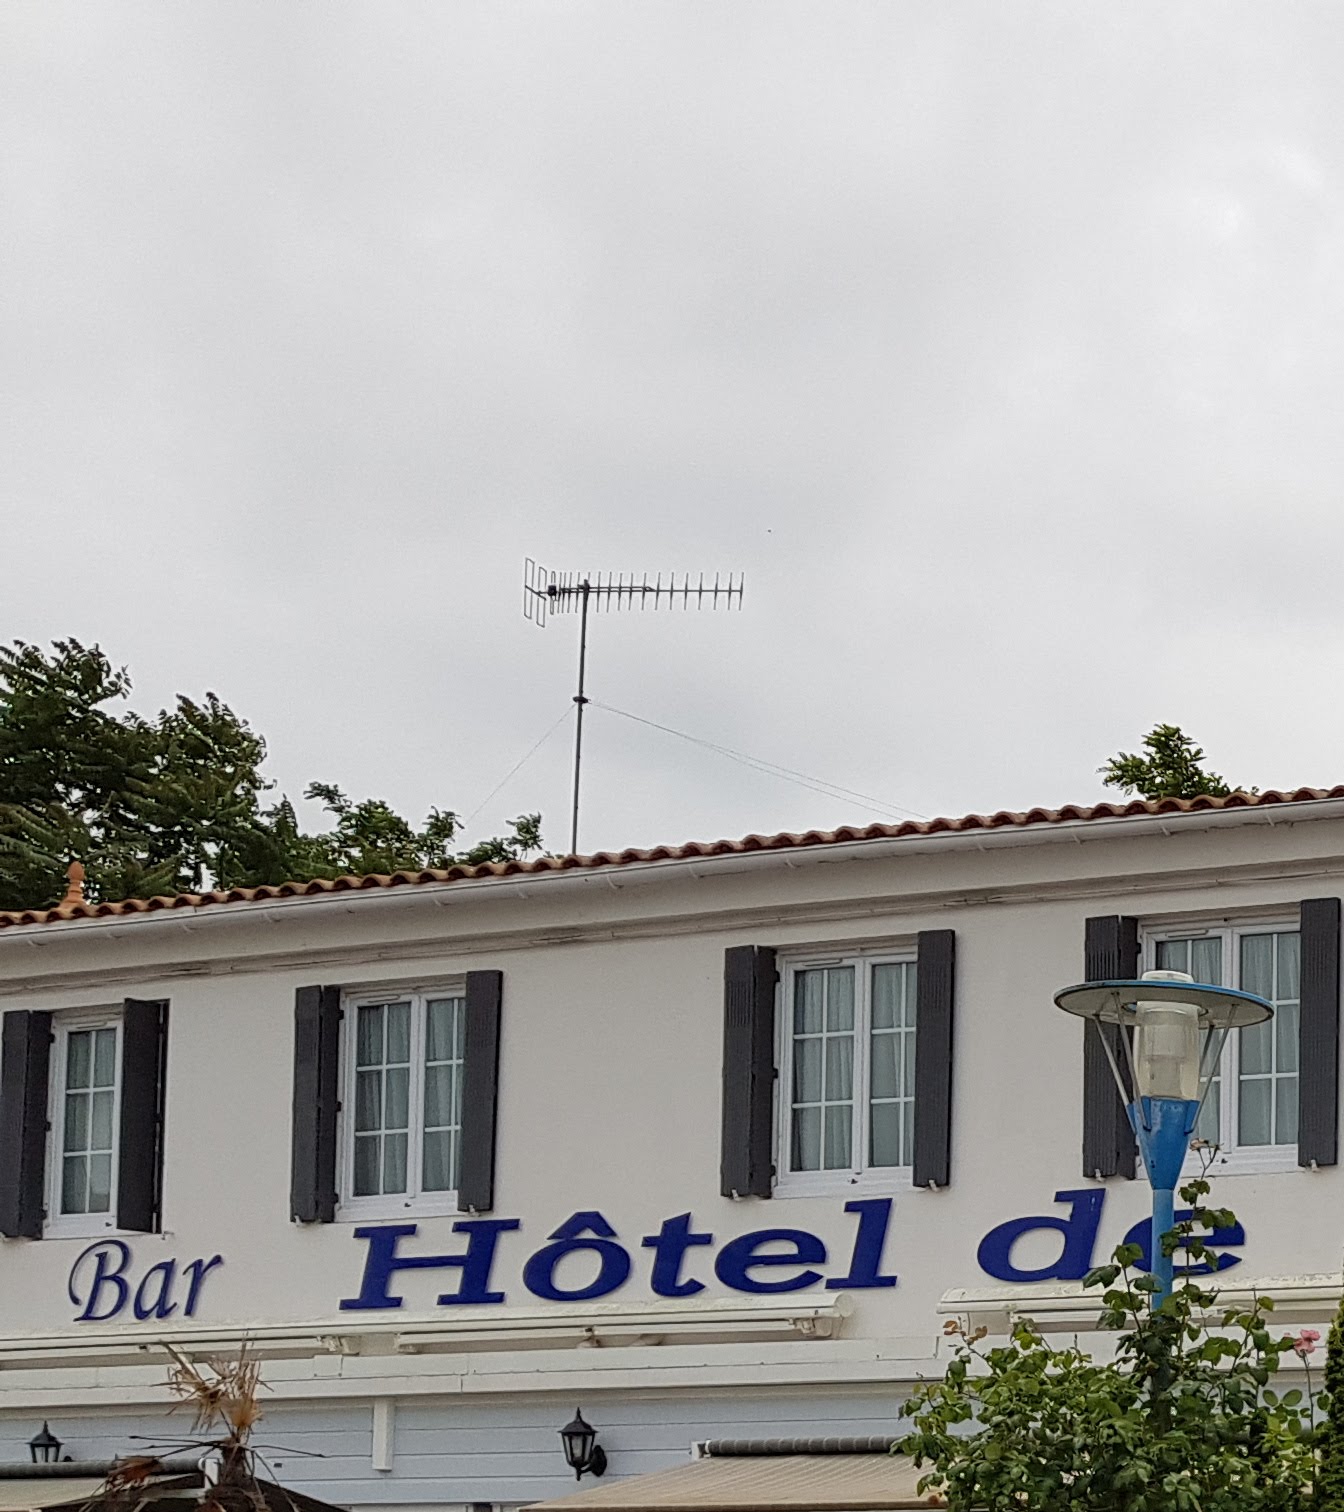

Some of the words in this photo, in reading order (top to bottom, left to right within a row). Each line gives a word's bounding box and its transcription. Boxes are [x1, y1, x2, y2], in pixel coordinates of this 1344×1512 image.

[68, 1239, 224, 1322] Bar
[339, 1198, 899, 1311] Hôtel
[977, 1188, 1245, 1282] de
